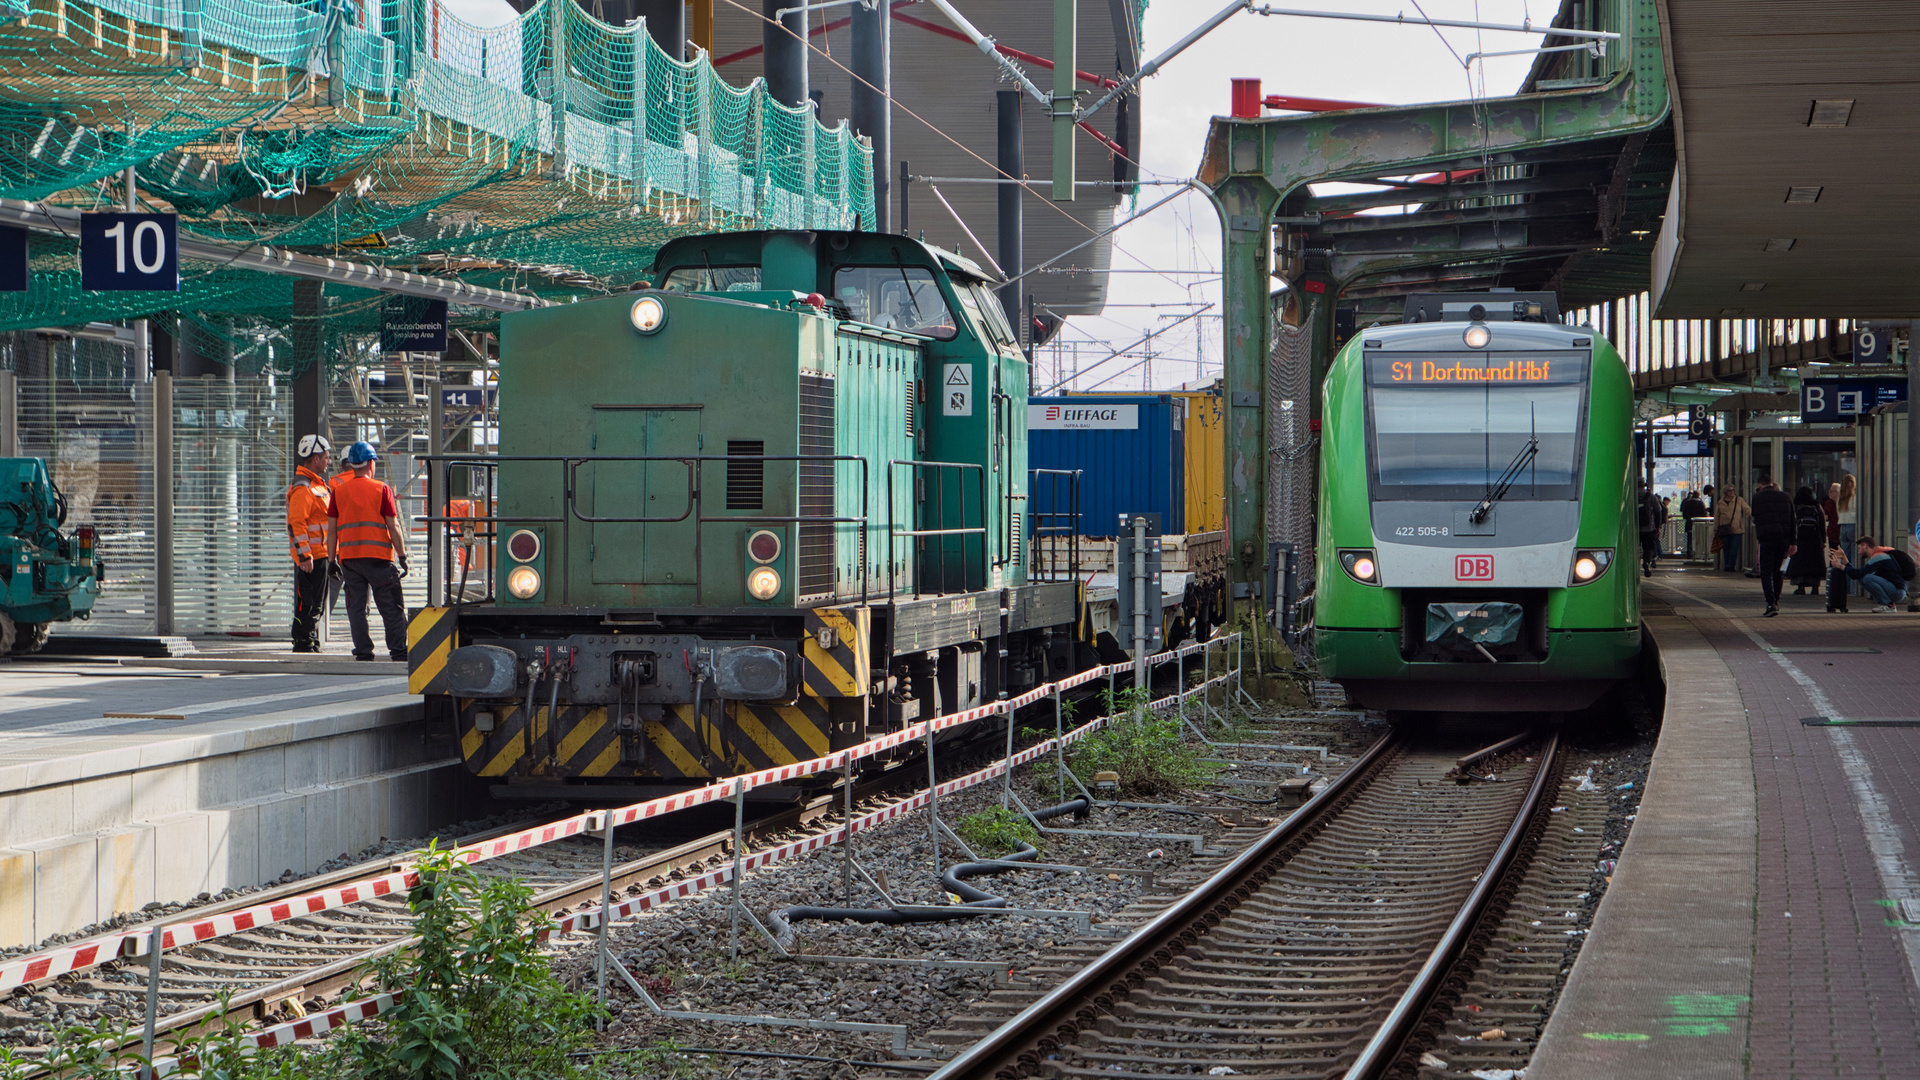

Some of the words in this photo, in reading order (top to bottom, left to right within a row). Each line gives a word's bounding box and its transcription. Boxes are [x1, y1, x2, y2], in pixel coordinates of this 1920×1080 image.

[104, 220, 166, 275] 10
[1859, 332, 1876, 357] 9
[1391, 361, 1413, 381] S1
[1422, 361, 1515, 381] Dortmund
[1517, 361, 1550, 381] Hbf
[446, 392, 468, 406] 11
[1806, 386, 1826, 413] B
[1064, 410, 1118, 420] EIFFAGE
[1696, 404, 1706, 419] 8
[1692, 420, 1703, 436] C
[1395, 526, 1415, 536] 422
[1418, 526, 1449, 536] 505-8
[1458, 557, 1491, 578] DB
[534, 645, 546, 654] HBL
[557, 645, 568, 654] HLL
[699, 646, 710, 654] HLL
